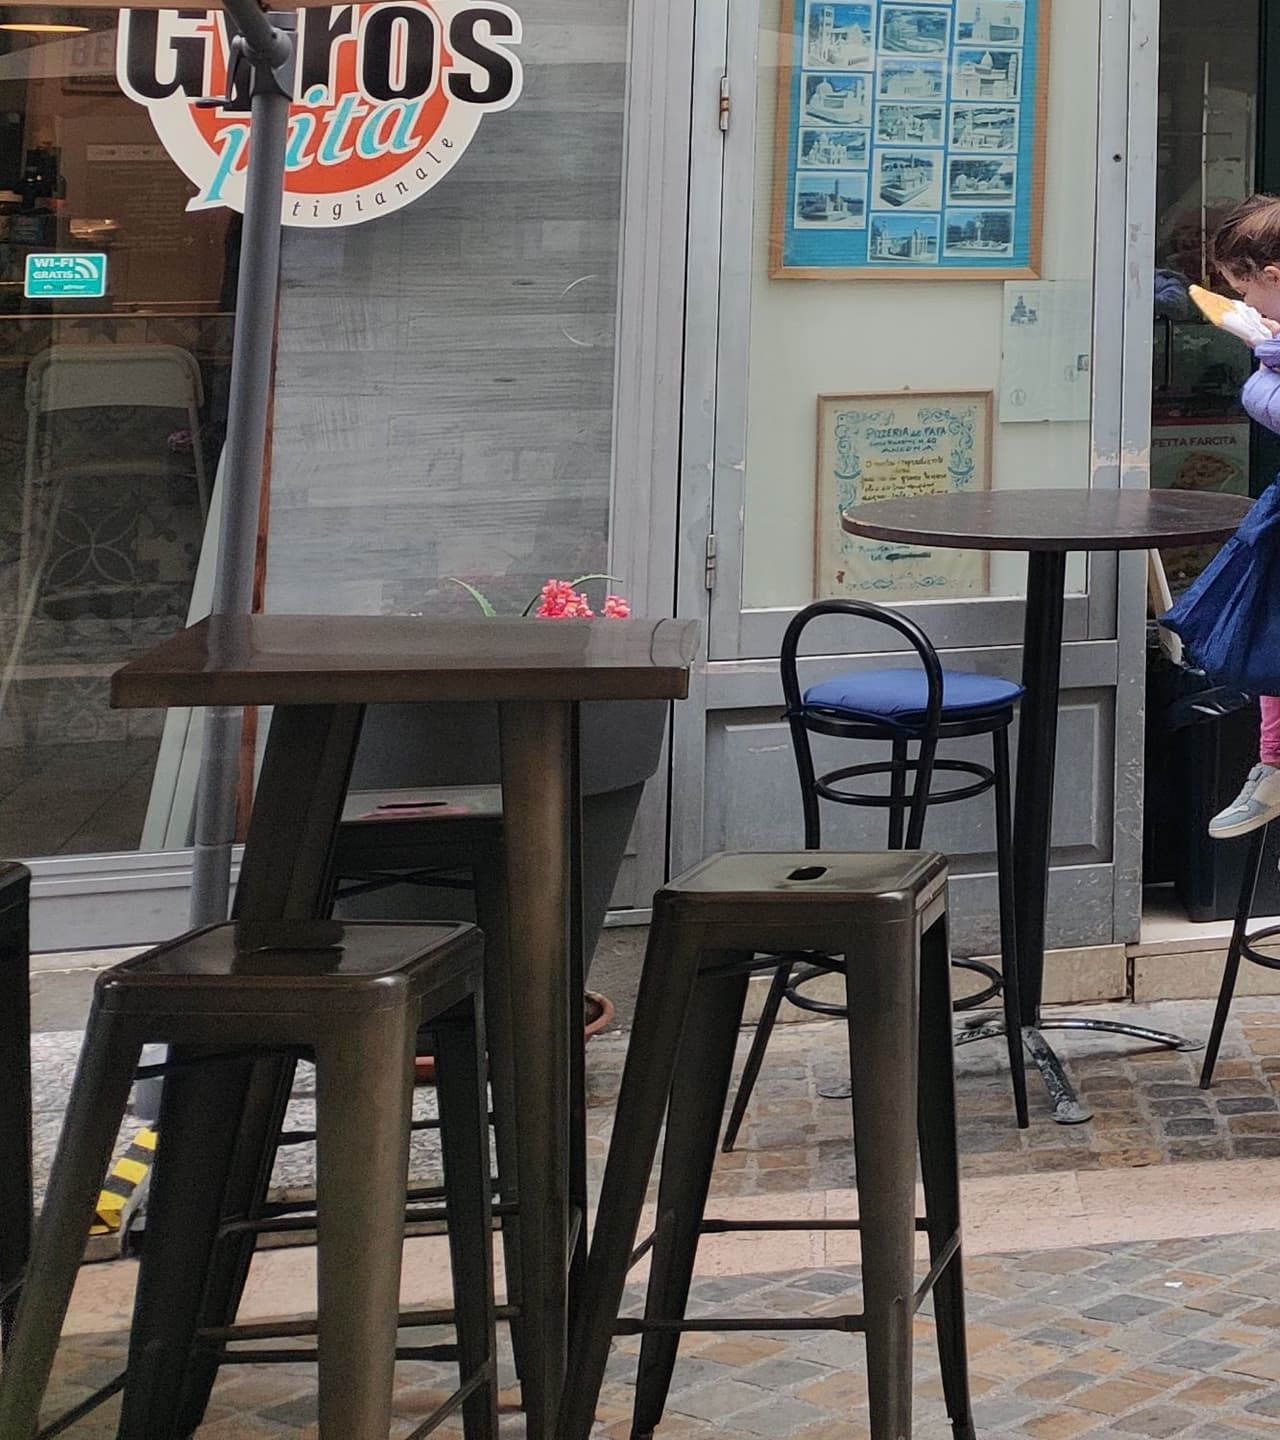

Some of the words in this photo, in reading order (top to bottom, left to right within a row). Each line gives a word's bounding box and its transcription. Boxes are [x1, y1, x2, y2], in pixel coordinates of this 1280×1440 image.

[291, 137, 455, 221] tigianale
[34, 258, 74, 267] WI-FI
[33, 271, 73, 279] GRATIS
[1190, 436, 1237, 446] FARCITA
